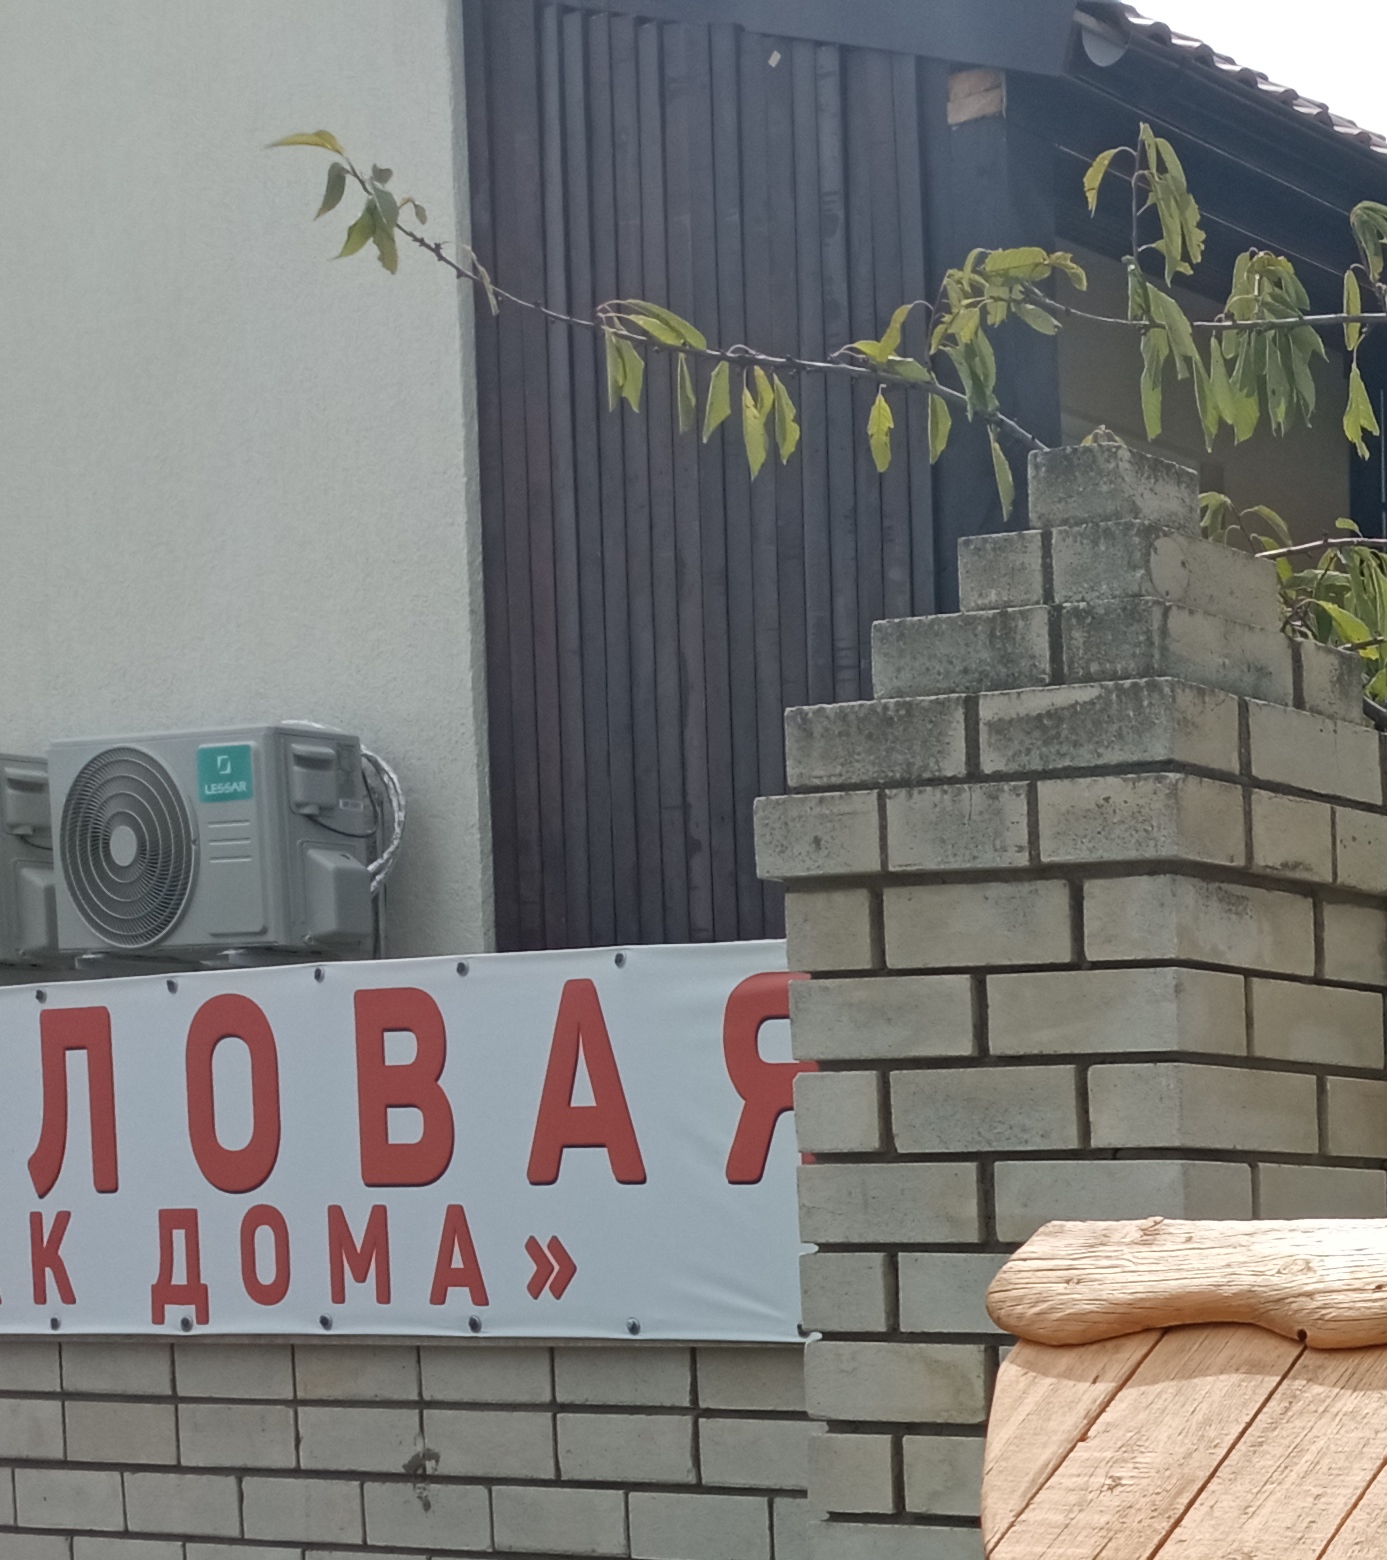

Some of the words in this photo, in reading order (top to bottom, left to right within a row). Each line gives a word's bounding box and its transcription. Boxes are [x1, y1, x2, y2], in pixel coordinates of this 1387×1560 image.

[205, 781, 247, 795] LESSAR
[28, 972, 820, 1198] ЛОВАЯ
[0, 1210, 77, 1305] К
[151, 1203, 578, 1325] ДОМА»
